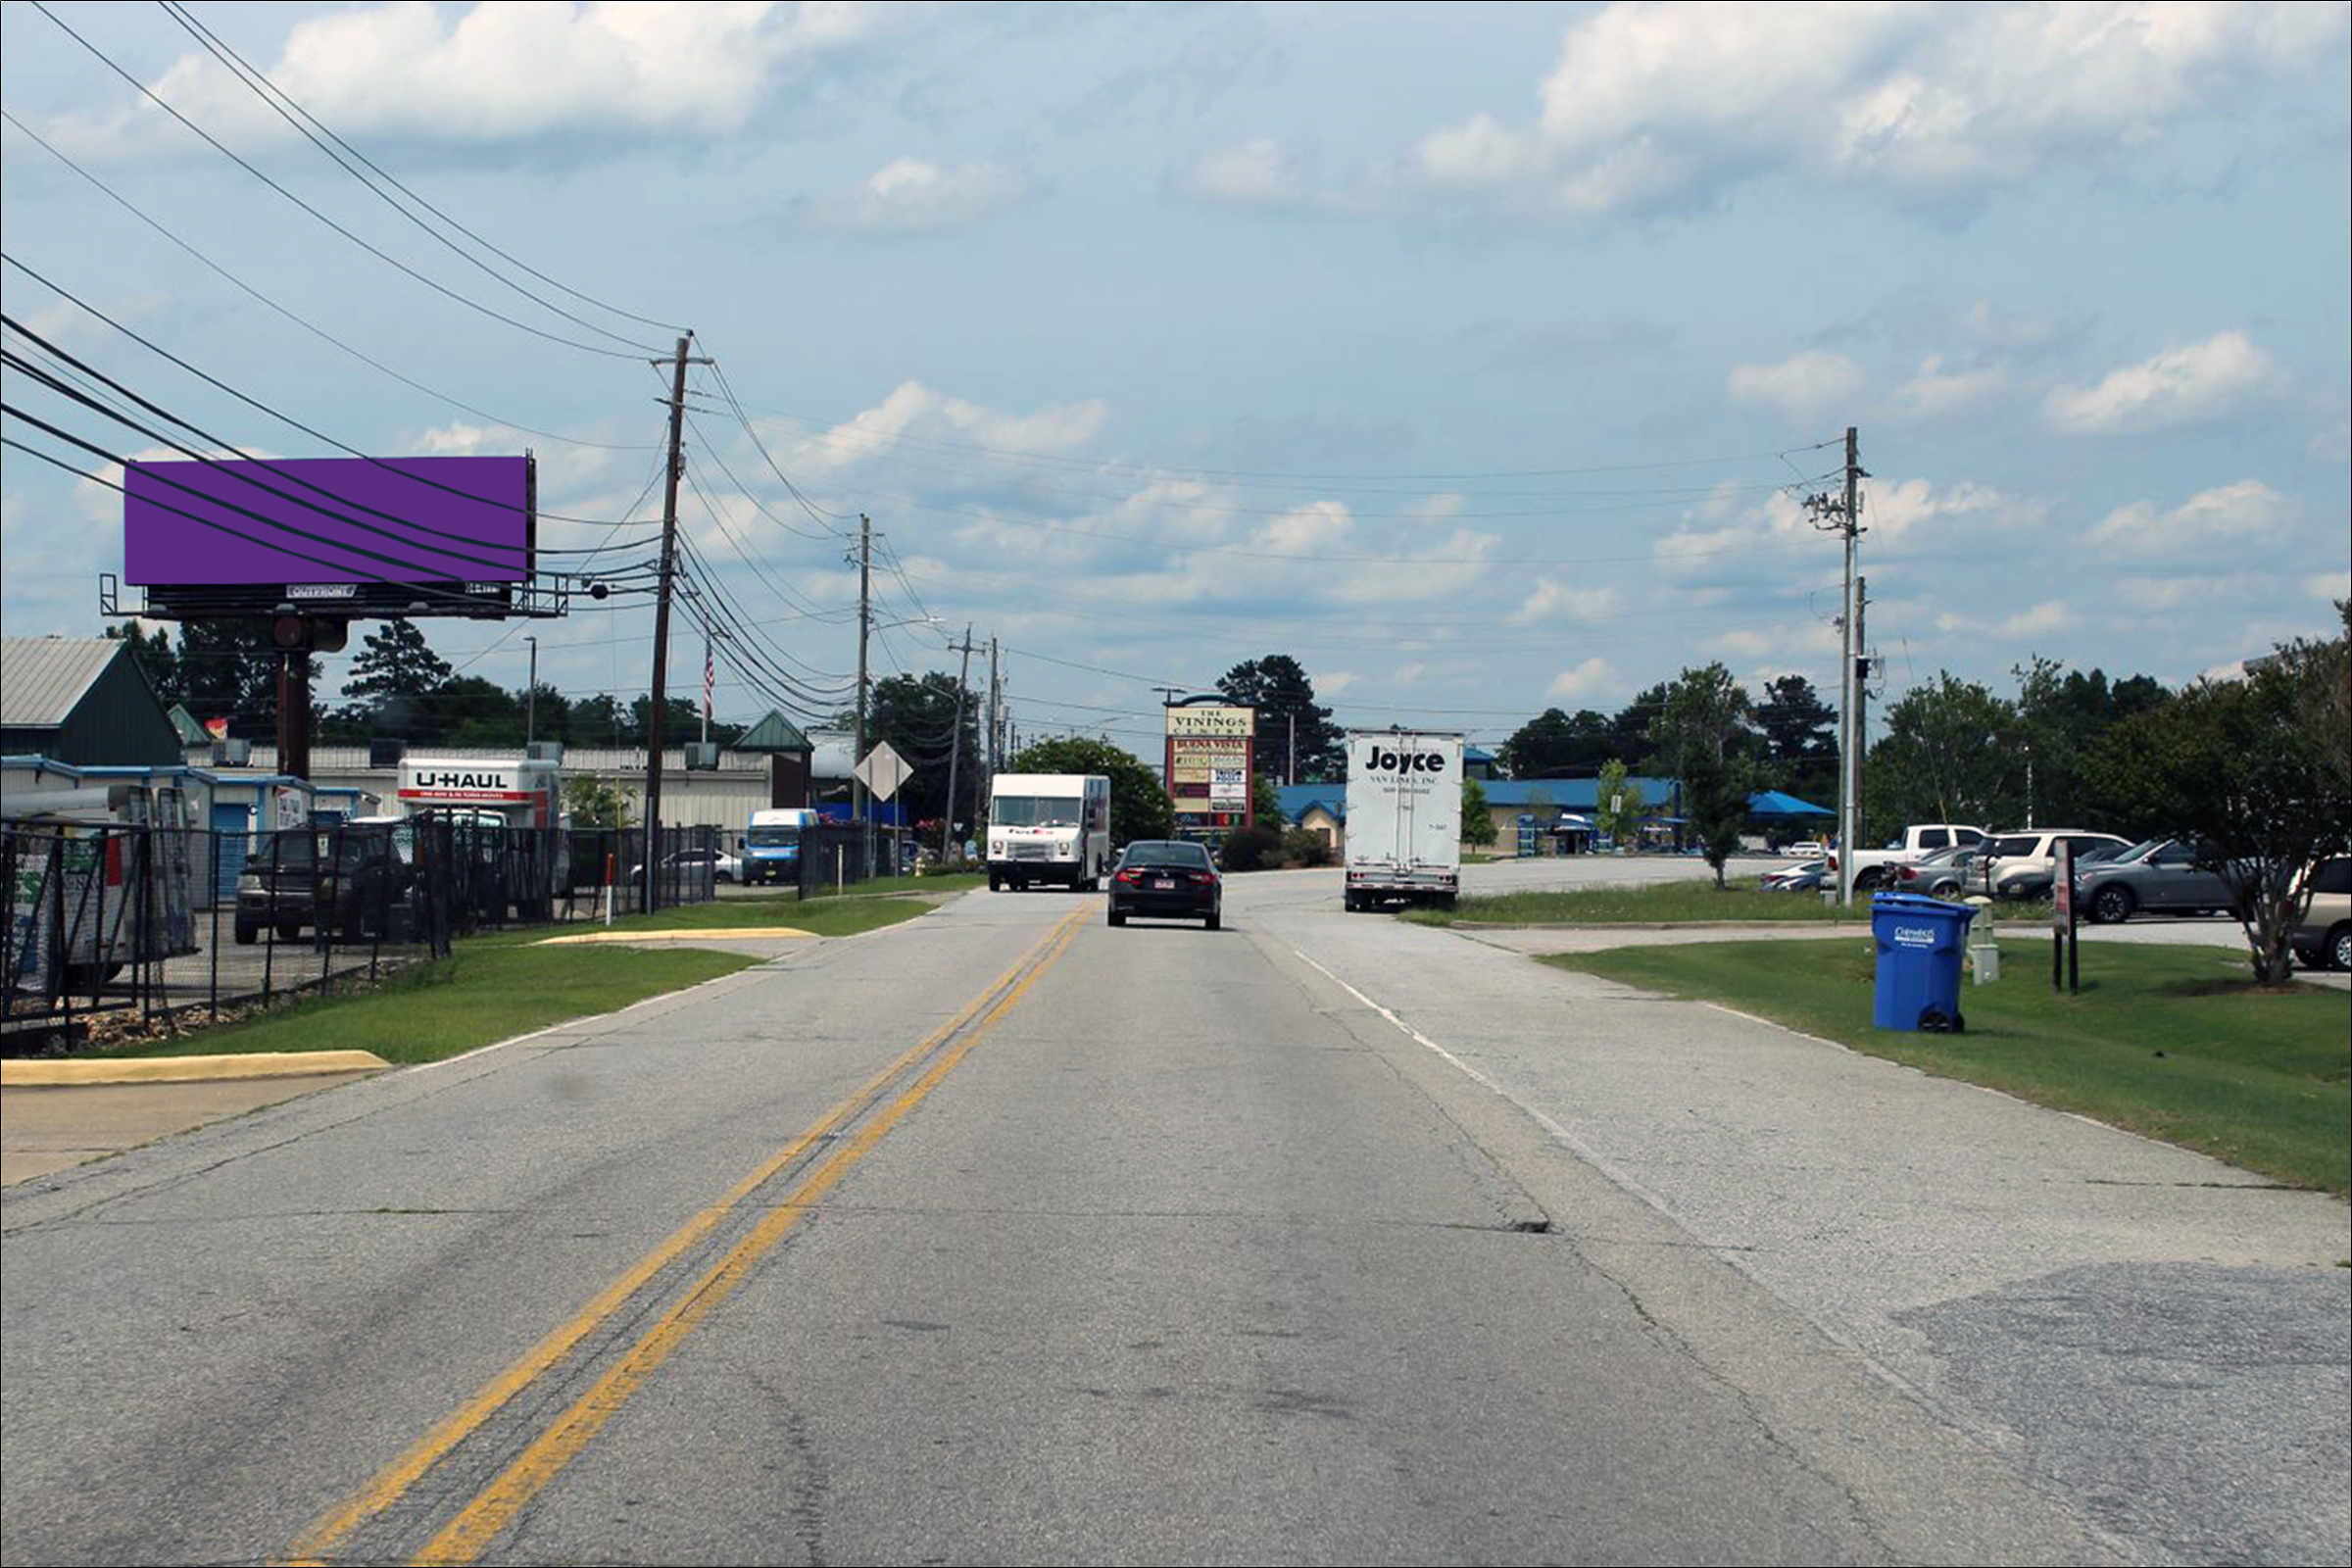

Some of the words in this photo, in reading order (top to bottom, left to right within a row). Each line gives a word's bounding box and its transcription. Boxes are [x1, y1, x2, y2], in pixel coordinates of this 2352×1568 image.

[1175, 717, 1247, 726] VININGS
[1177, 740, 1213, 749] BUENA
[1215, 740, 1244, 749] VISTA
[1365, 746, 1446, 774] Joyce
[416, 772, 508, 788] U-HAUL
